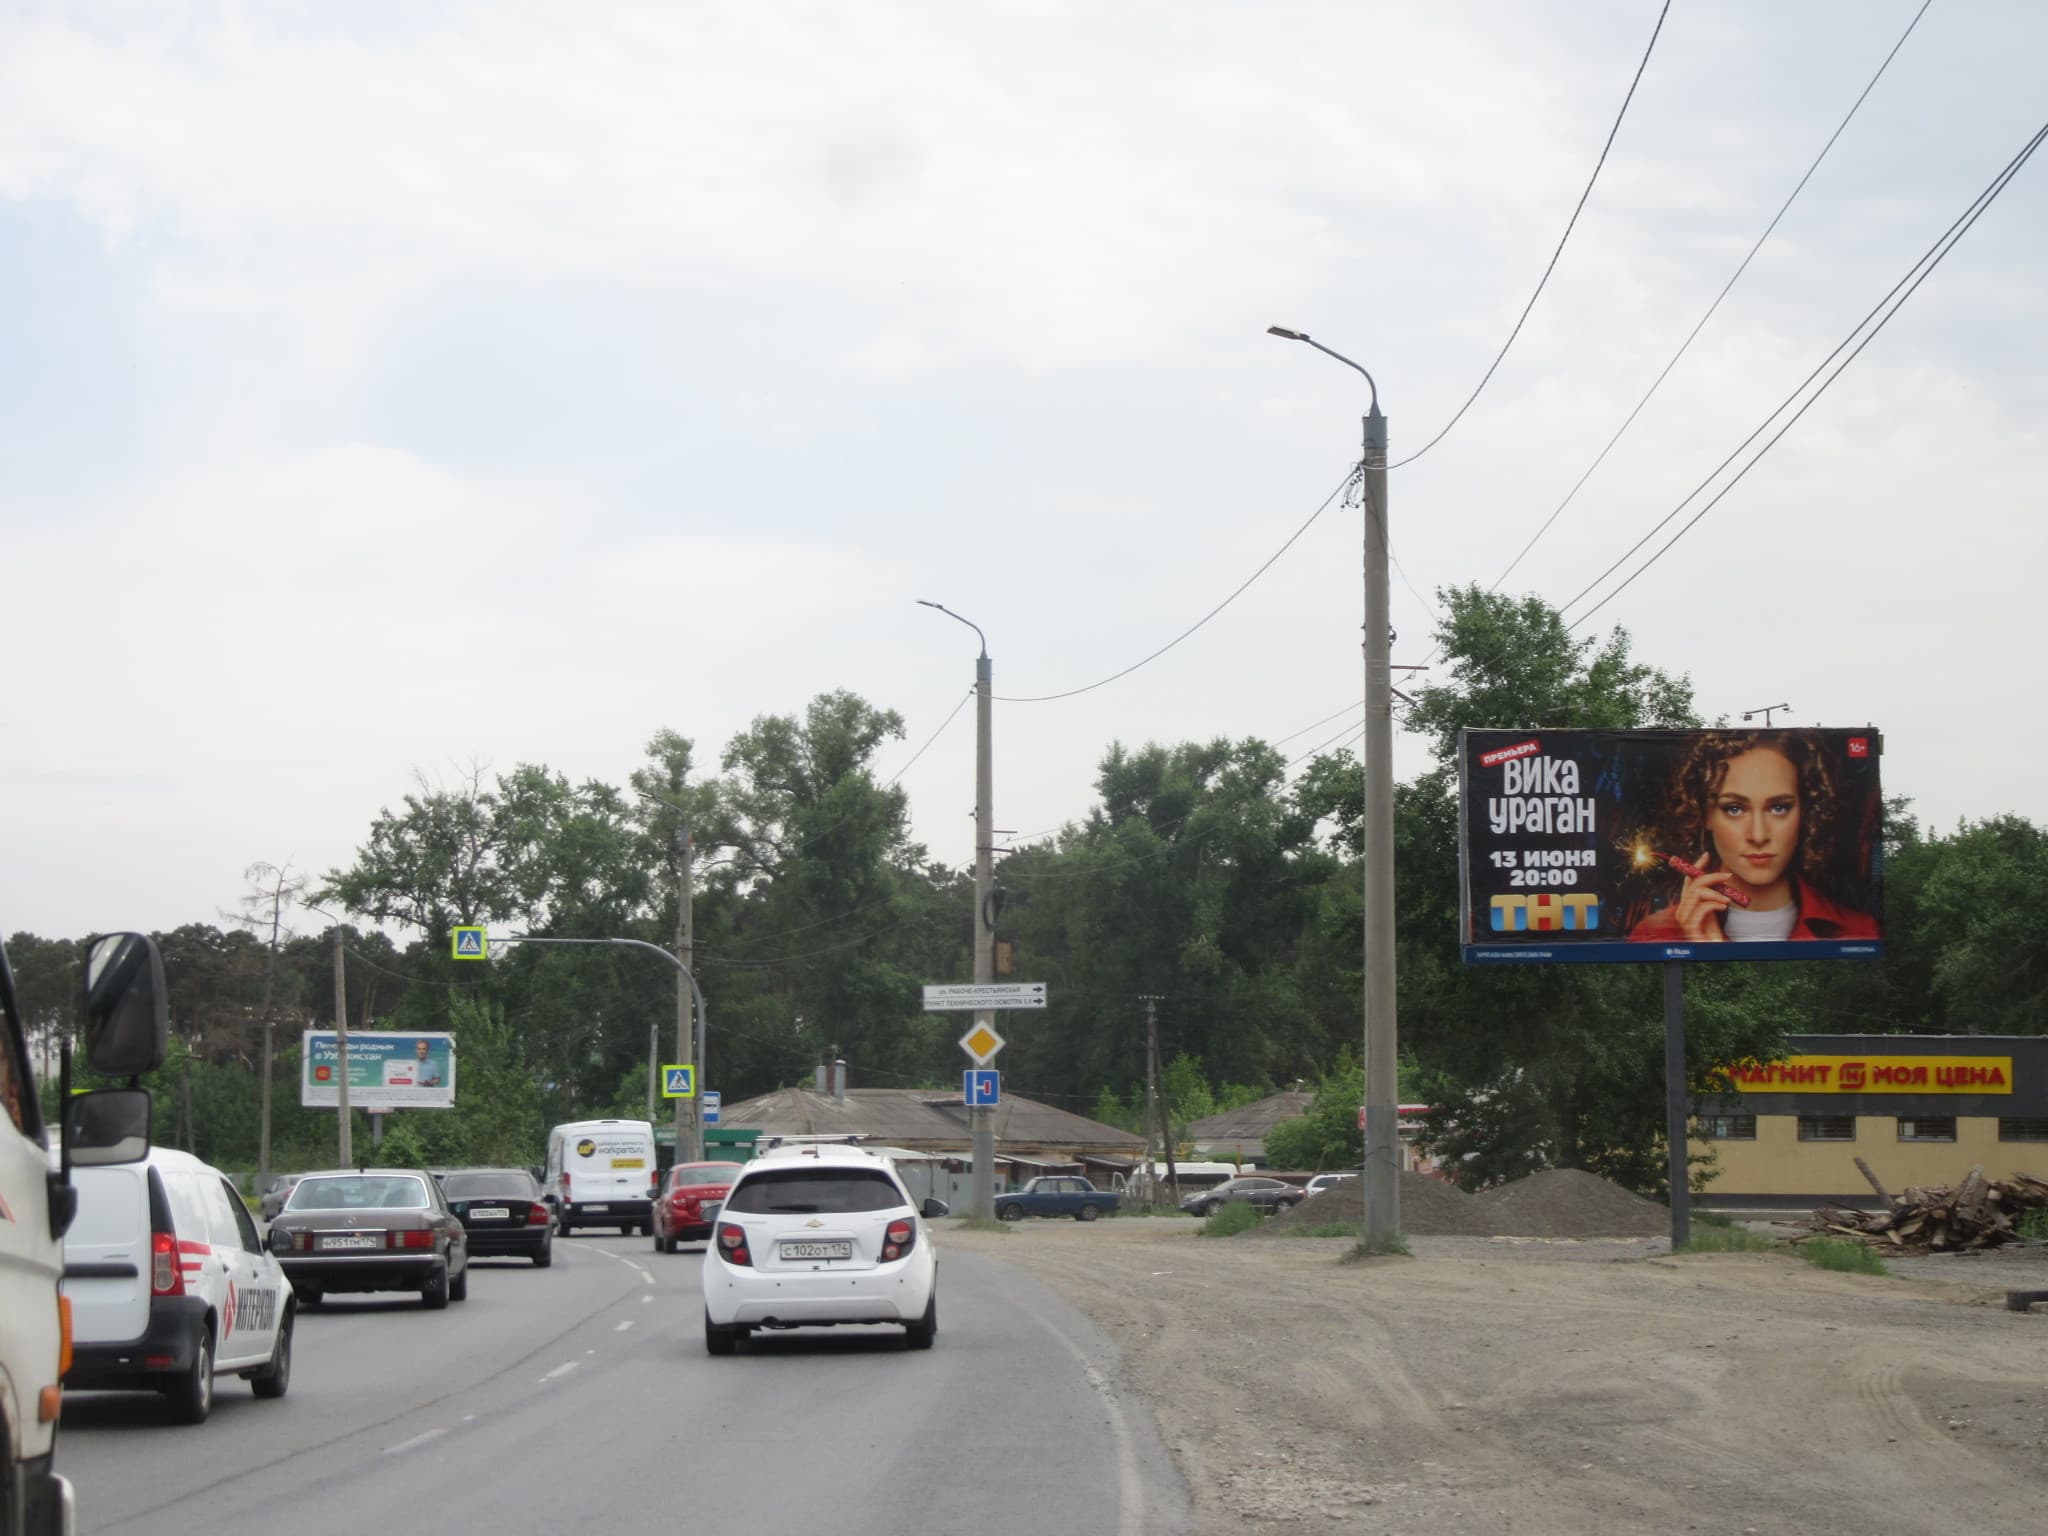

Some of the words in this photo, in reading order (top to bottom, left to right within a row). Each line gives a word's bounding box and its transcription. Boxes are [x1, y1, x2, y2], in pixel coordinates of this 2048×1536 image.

[1484, 742, 1537, 764] ПРЕМЬЕРА
[1849, 743, 1865, 753] 16+
[1489, 851, 1517, 868] 13
[1524, 850, 1597, 868] ИЮНЯ
[1510, 869, 1578, 887] 20:00
[1491, 893, 1599, 932] ТНТ
[1729, 1065, 1831, 1084] МАГНИТ
[1873, 1065, 1928, 1084] МОЯ
[1936, 1066, 2005, 1088] ЦЕНА
